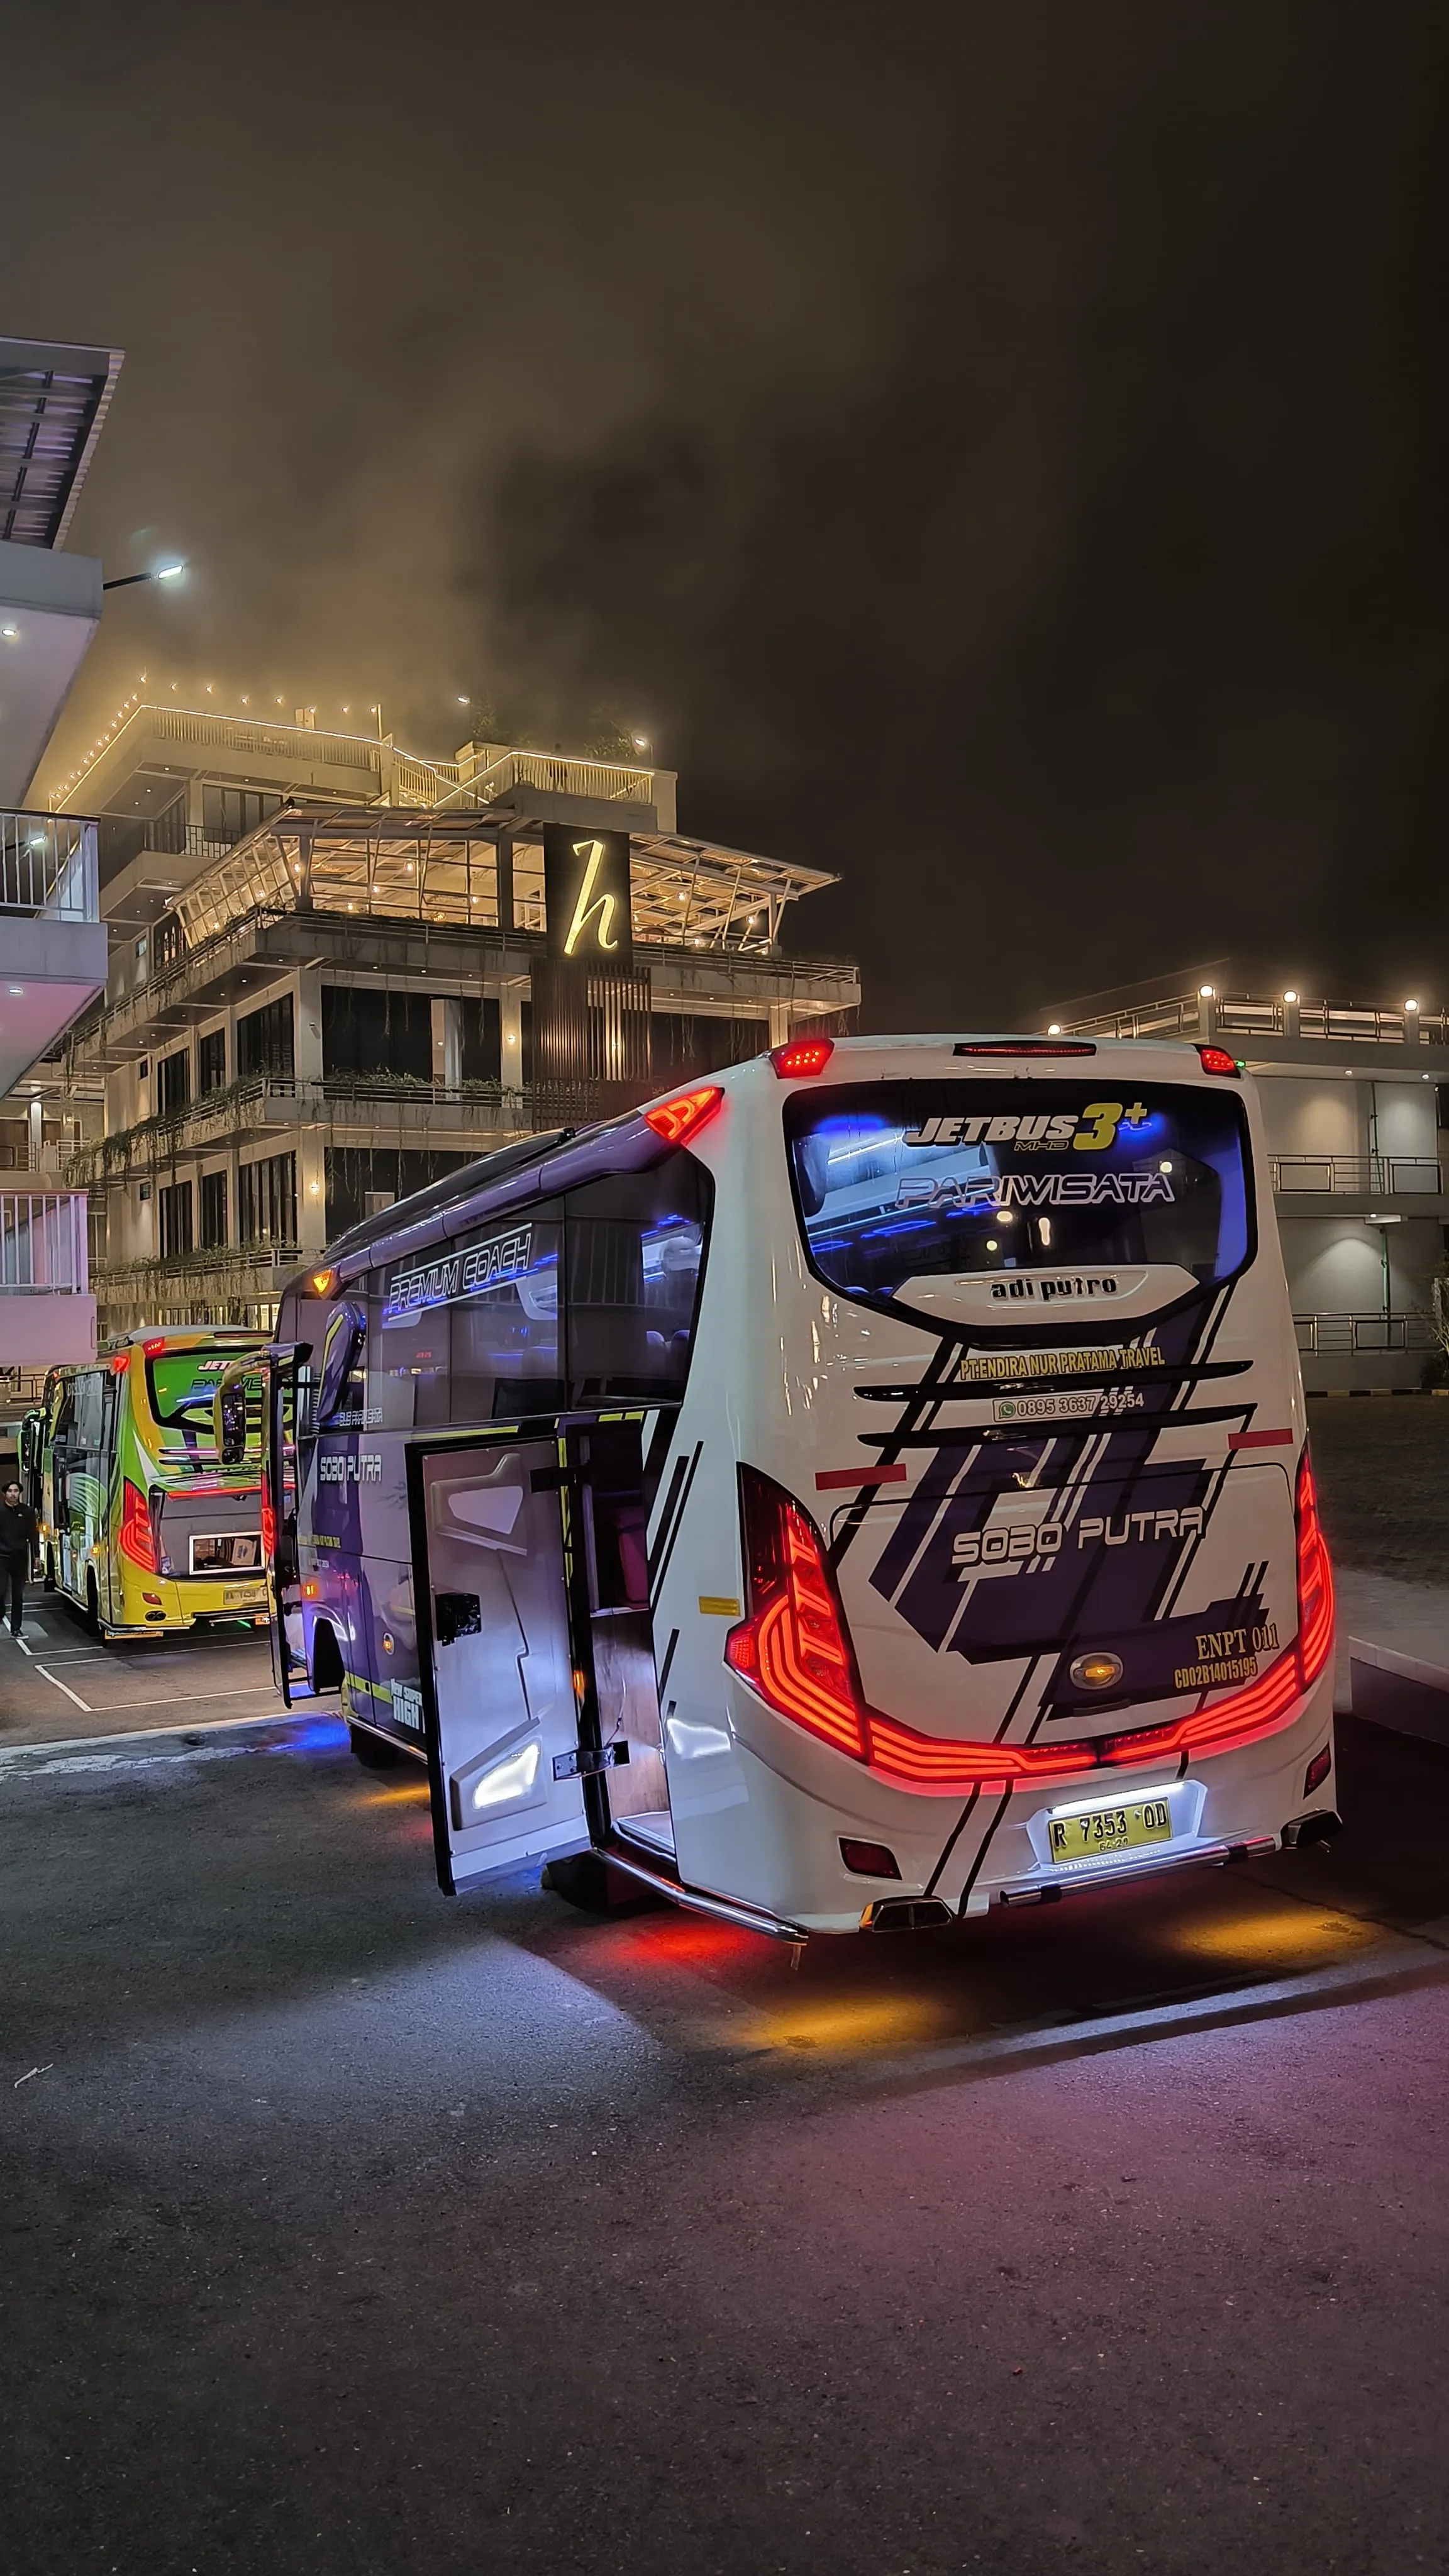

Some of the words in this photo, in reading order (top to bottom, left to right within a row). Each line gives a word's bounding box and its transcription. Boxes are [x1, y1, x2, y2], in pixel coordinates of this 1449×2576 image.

[1014, 1140, 1069, 1151] MHD
[894, 1174, 1175, 1209] PARIWISATA
[389, 1260, 459, 1313] PREMIUM
[462, 1233, 531, 1289] COACH
[991, 1279, 1033, 1298] adi
[1040, 1277, 1117, 1301] putro
[1030, 1354, 1057, 1375] NUR
[1060, 1350, 1117, 1372] PRATAMA
[1119, 1346, 1165, 1368] TRAVEL
[1017, 1399, 1055, 1416] 0895
[1059, 1396, 1096, 1413] 3637
[1100, 1392, 1145, 1410] 29254
[320, 1456, 344, 1481] SOBO
[347, 1454, 382, 1482] PUTRA
[952, 1522, 1062, 1564] SOBO
[1078, 1506, 1202, 1549] PUTRA
[1196, 1629, 1246, 1660] ENPT
[1252, 1623, 1279, 1651] 011
[393, 1695, 419, 1730] HIGH
[1053, 1823, 1067, 1848] R
[1079, 1809, 1126, 1842] 7353
